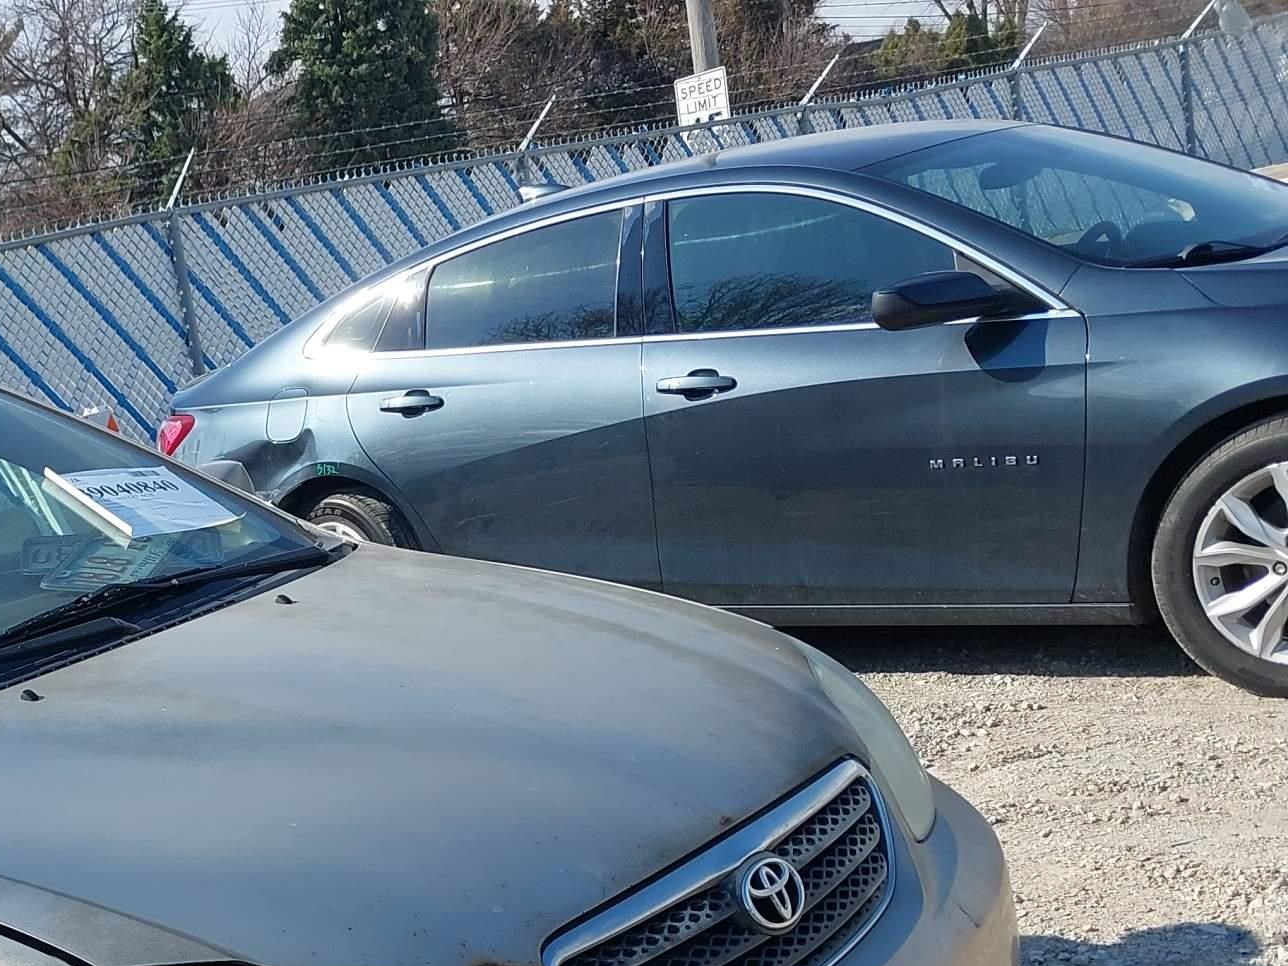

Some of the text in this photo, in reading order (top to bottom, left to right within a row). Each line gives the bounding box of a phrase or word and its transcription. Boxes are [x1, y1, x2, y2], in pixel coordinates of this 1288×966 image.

[681, 78, 722, 100] SPEED
[687, 95, 718, 114] LIMIT
[929, 455, 1039, 469] MALIBU
